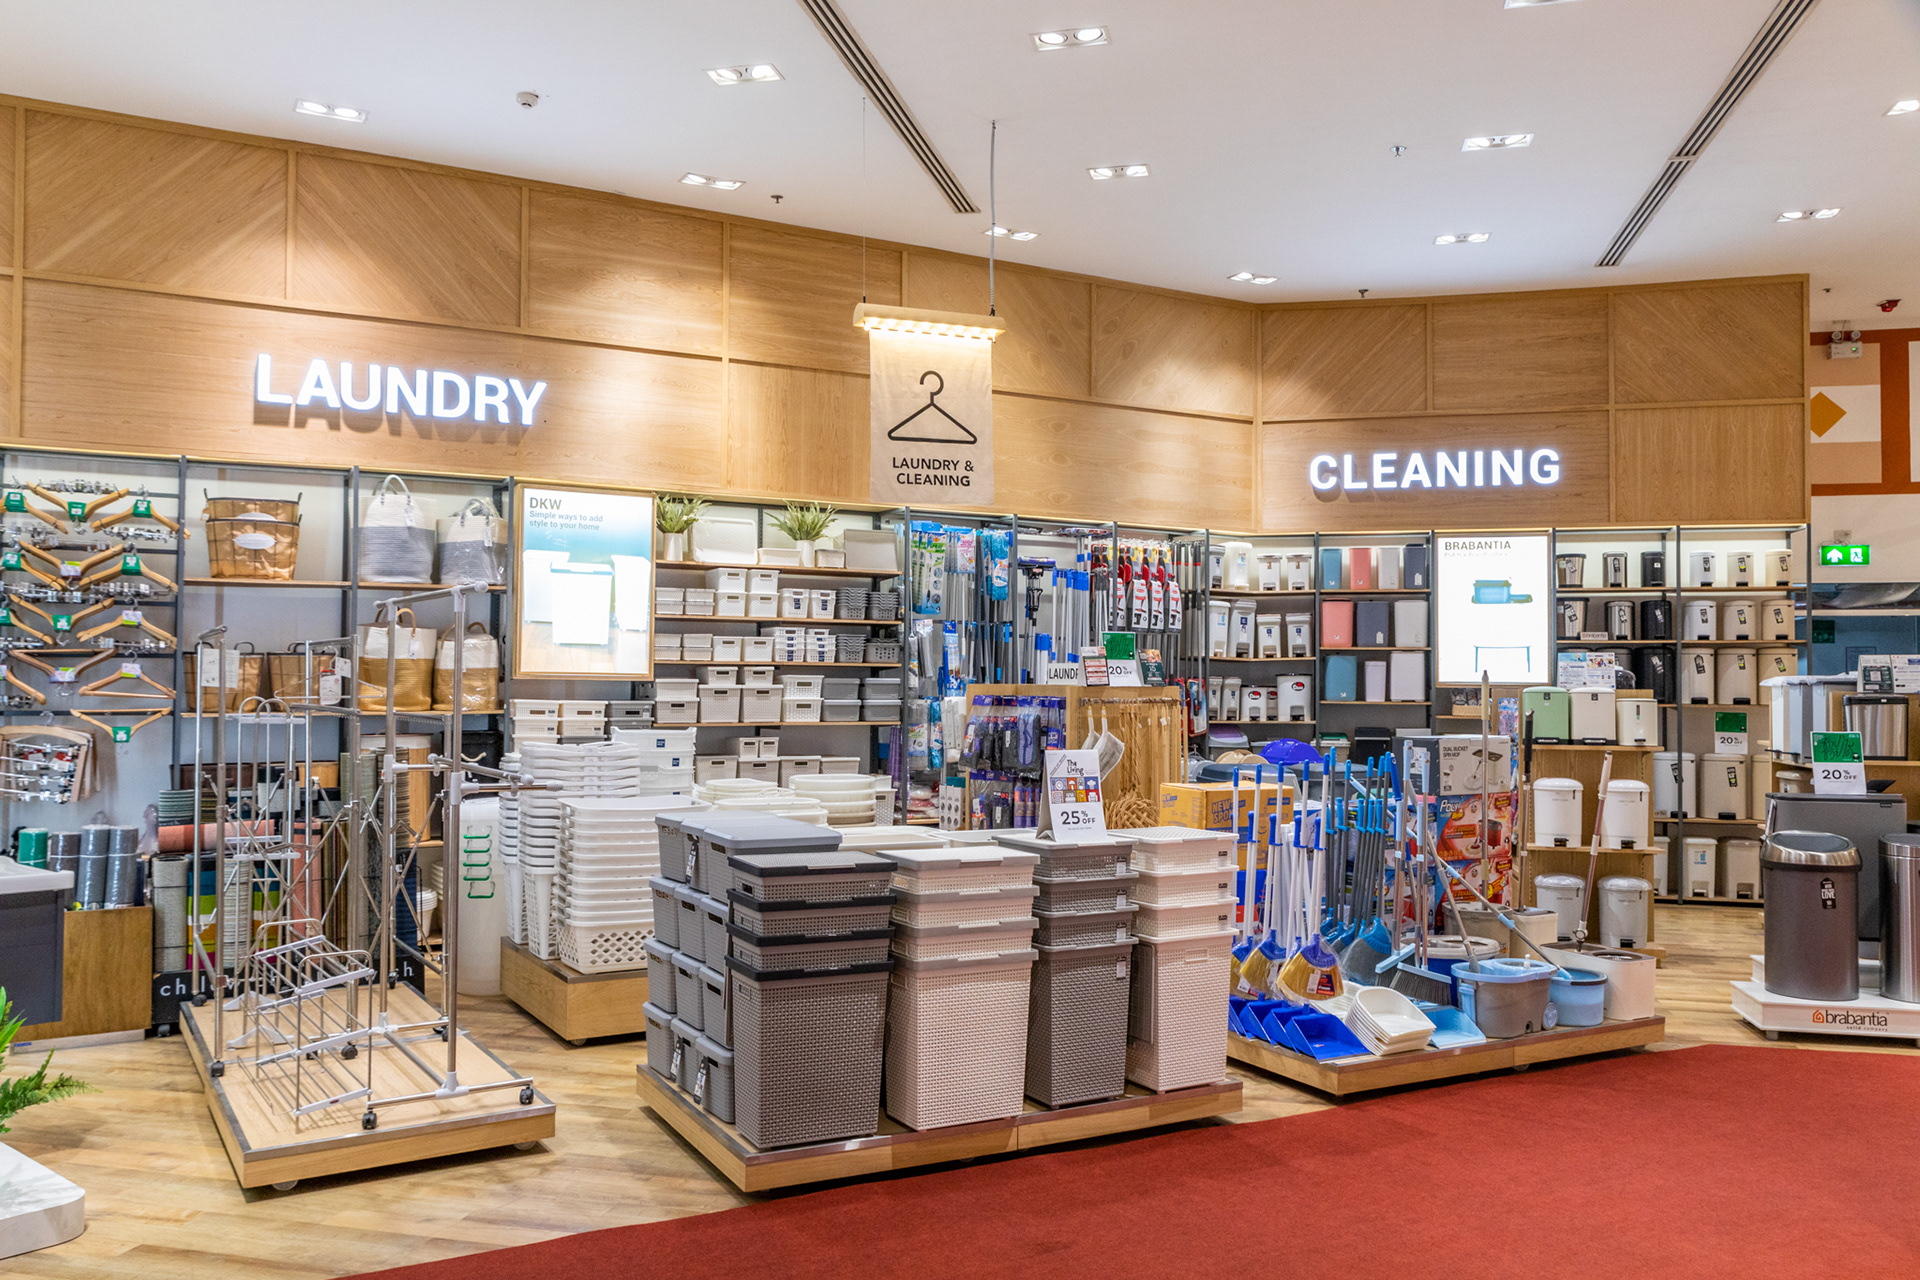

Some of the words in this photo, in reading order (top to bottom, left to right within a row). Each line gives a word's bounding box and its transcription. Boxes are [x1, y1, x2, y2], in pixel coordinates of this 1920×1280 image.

[256, 353, 548, 426] LAUNDRY
[892, 457, 959, 471] LAUNDRY
[964, 460, 974, 472] &
[1309, 448, 1560, 490] CLEANING
[896, 473, 970, 487] CLEANING
[529, 497, 562, 510] DKW
[529, 510, 557, 520] Simple
[558, 513, 578, 522] ways
[589, 514, 603, 522] add
[529, 519, 548, 528] style
[550, 520, 558, 528] to
[560, 522, 576, 530] your
[578, 522, 600, 531] home
[1444, 540, 1512, 551] BRABANTIA
[1108, 665, 1122, 675] 20
[1719, 736, 1734, 744] 20
[1067, 759, 1077, 767] The
[1067, 766, 1085, 776] Living
[1822, 769, 1841, 780] 20
[1212, 799, 1232, 814] NEW
[1060, 810, 1080, 825] 25
[1826, 1009, 1888, 1027] brabantia
